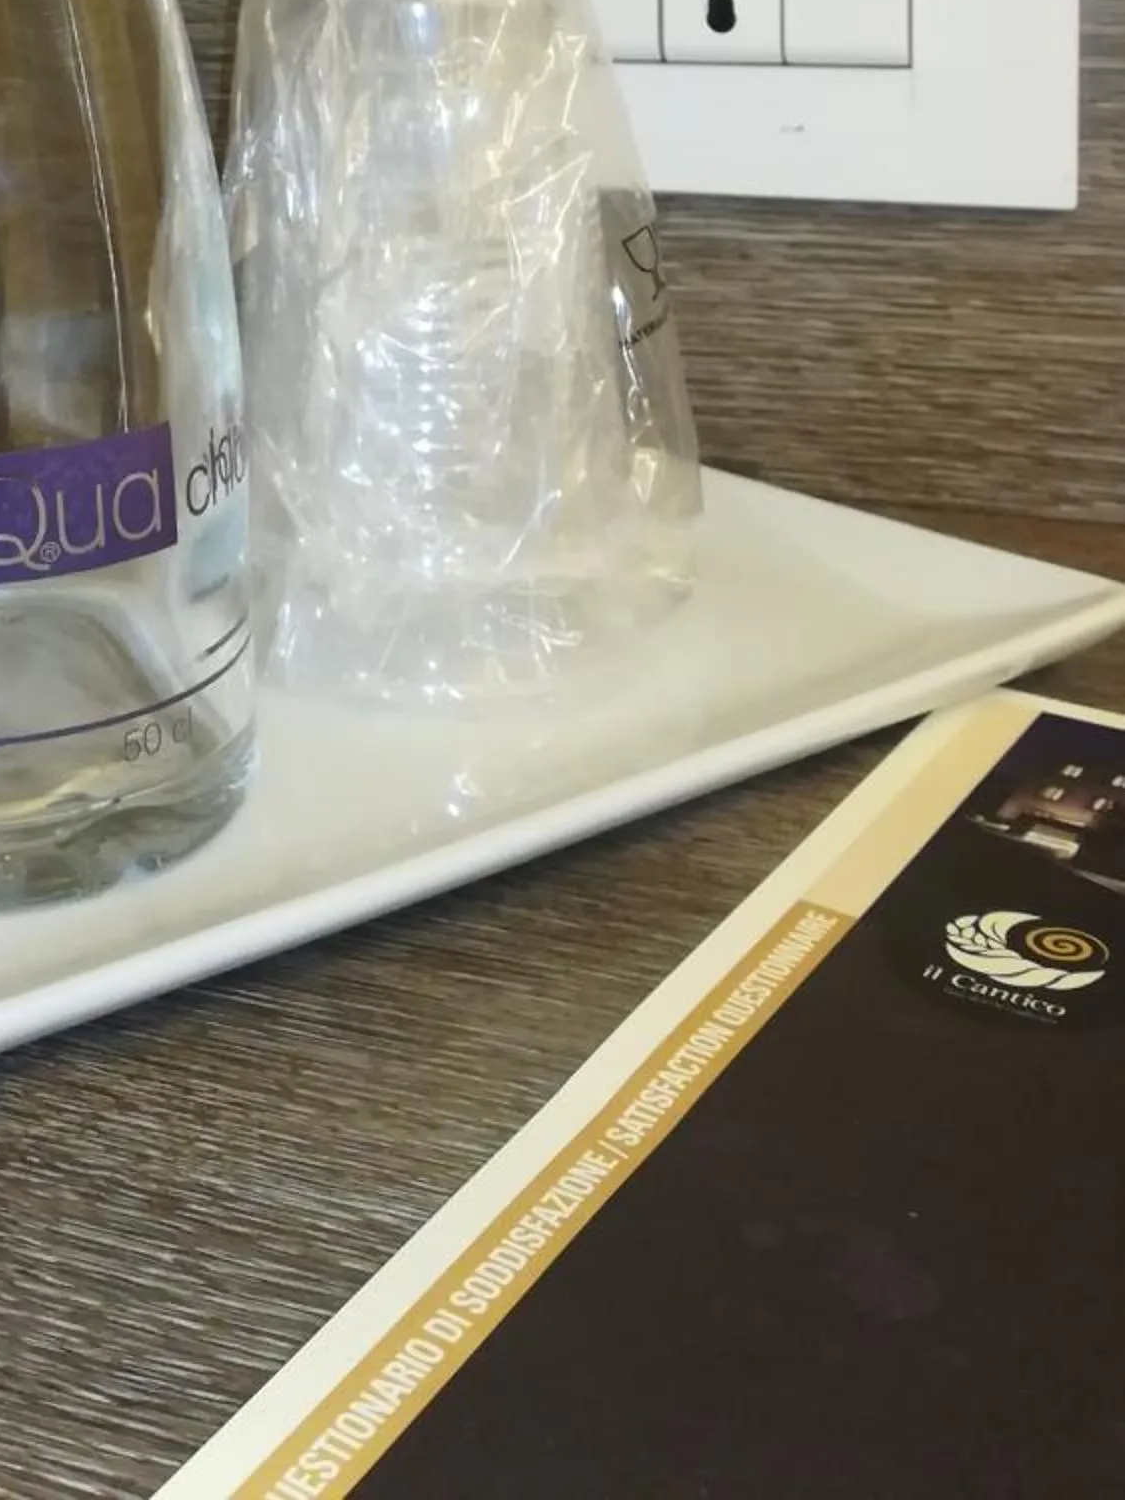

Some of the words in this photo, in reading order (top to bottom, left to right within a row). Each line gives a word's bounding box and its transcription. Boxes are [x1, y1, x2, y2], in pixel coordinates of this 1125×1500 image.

[124, 721, 162, 762] 50
[922, 964, 944, 981] il
[950, 974, 1067, 1017] Cantico
[422, 1308, 473, 1344] DI
[449, 1150, 619, 1315] SODDISFAZIONE
[605, 1020, 736, 1146] SATISFACTION
[712, 909, 840, 1026] QUESTIONNAIRE
